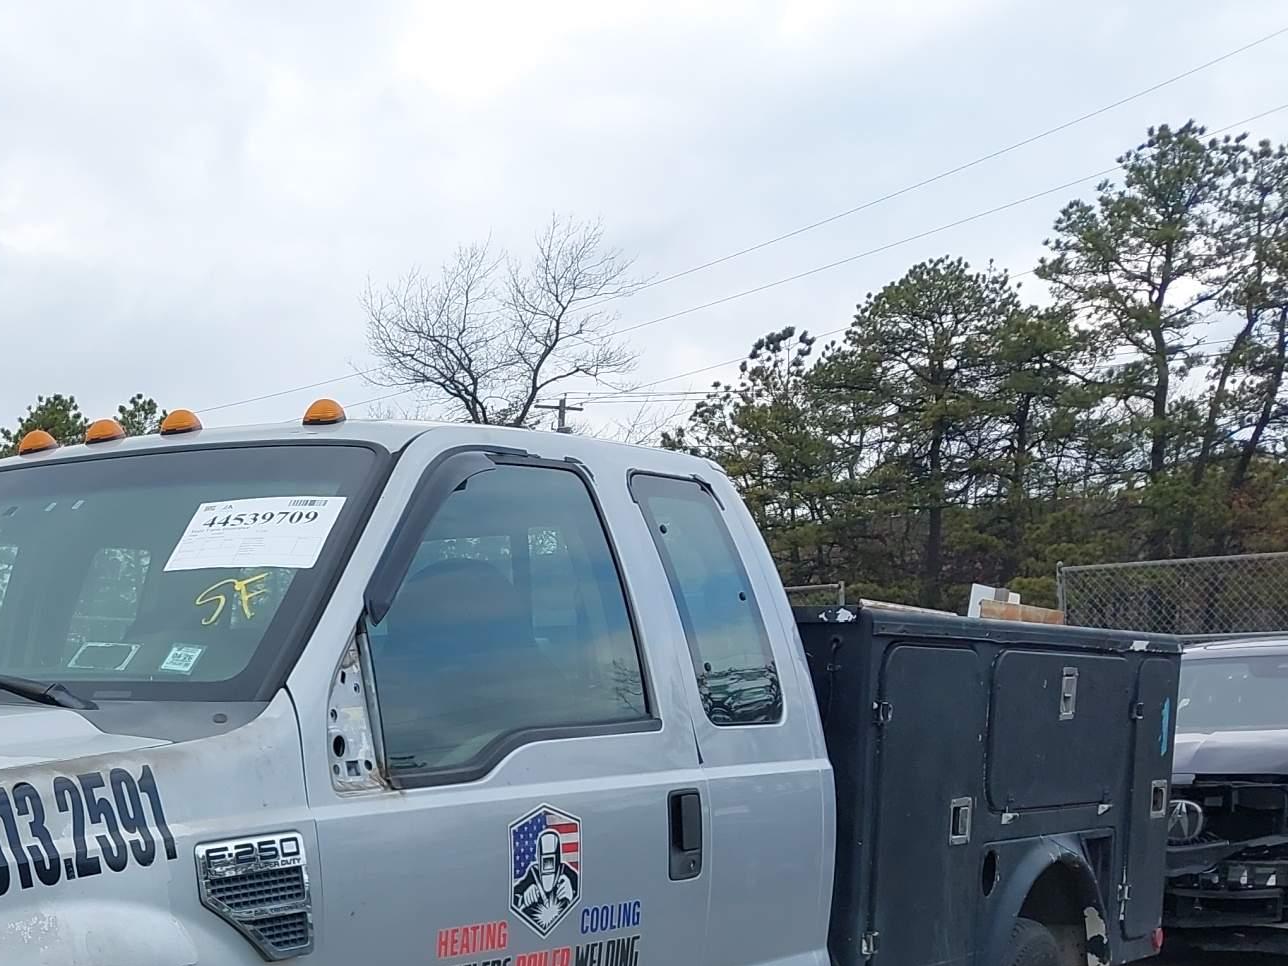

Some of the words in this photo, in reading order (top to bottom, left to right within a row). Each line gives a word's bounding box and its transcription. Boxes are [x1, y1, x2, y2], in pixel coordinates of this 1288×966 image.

[202, 511, 319, 528] 44539709
[280, 857, 302, 867] DUTY
[437, 921, 508, 959] HEATING
[581, 900, 641, 935] COOLING
